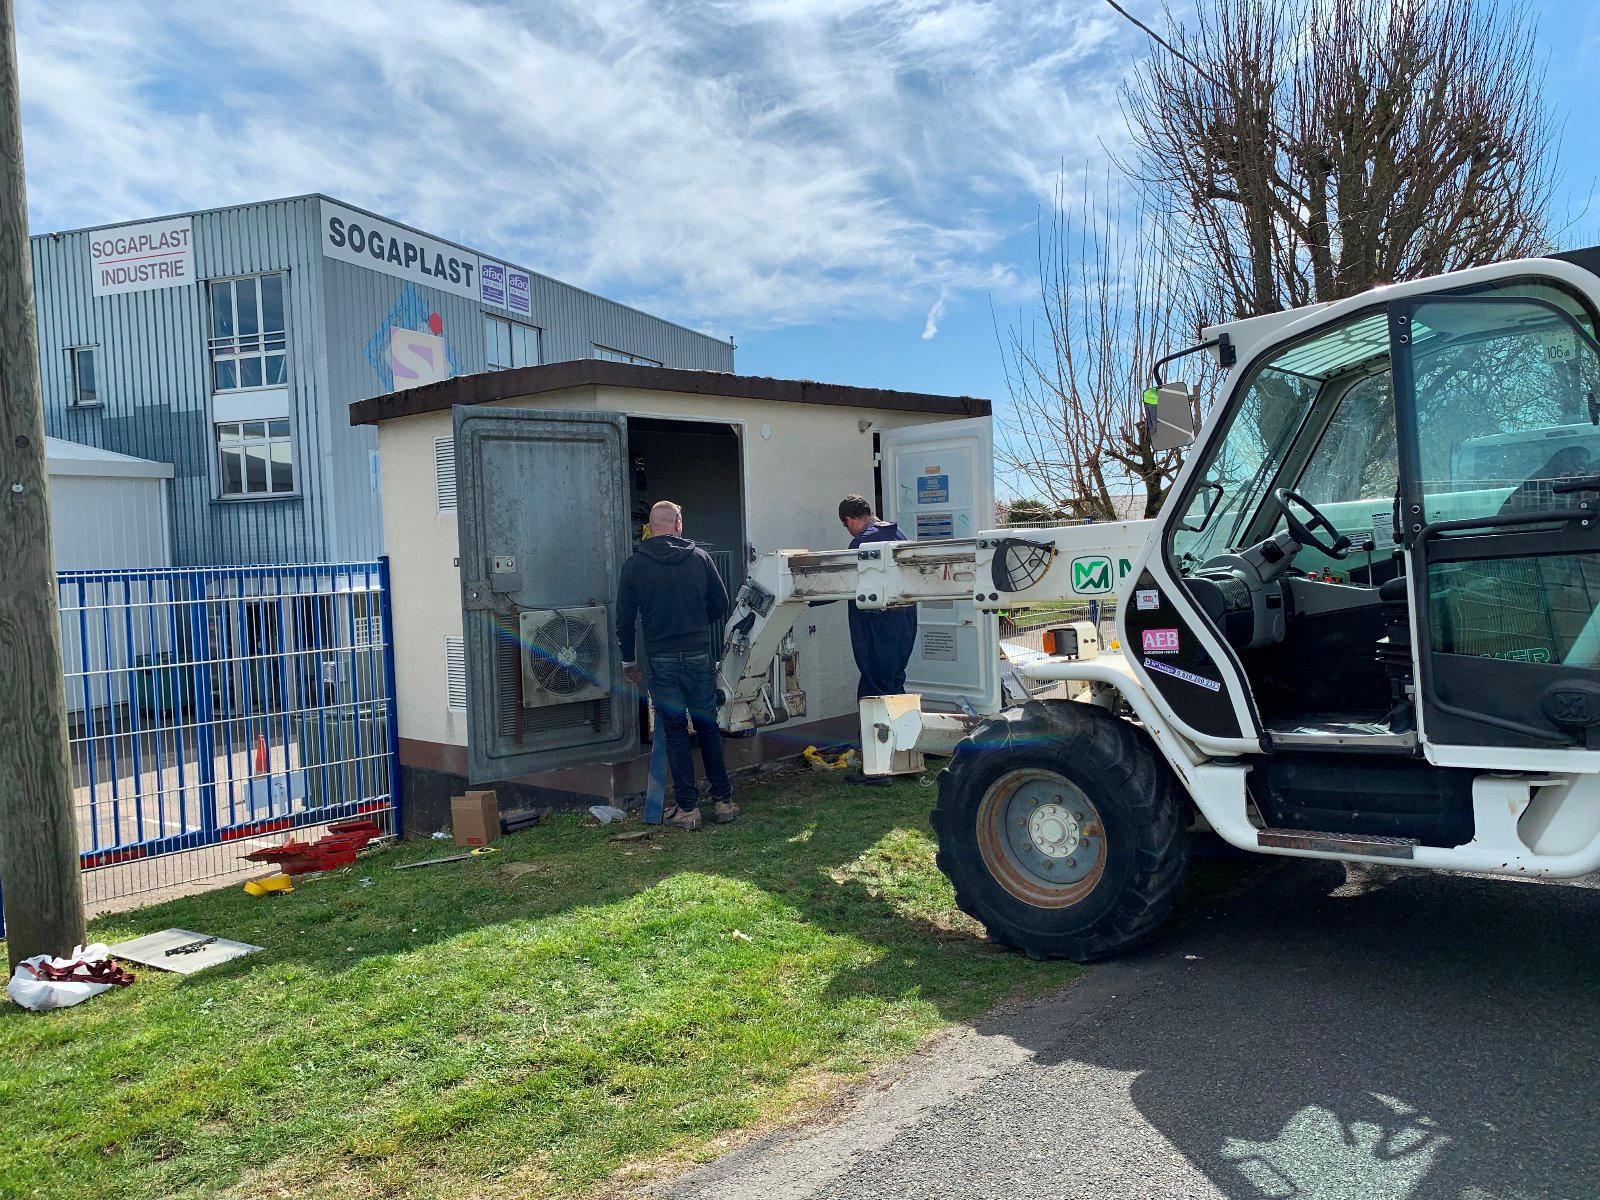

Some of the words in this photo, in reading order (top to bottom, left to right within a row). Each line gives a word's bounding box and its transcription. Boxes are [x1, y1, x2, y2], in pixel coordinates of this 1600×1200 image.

[91, 229, 190, 258] SOGAPLAST
[329, 216, 474, 288] SOGAPLAST
[101, 260, 185, 286] INDUSTRIE
[1546, 345, 1563, 359] 106
[1144, 631, 1178, 648] AEB
